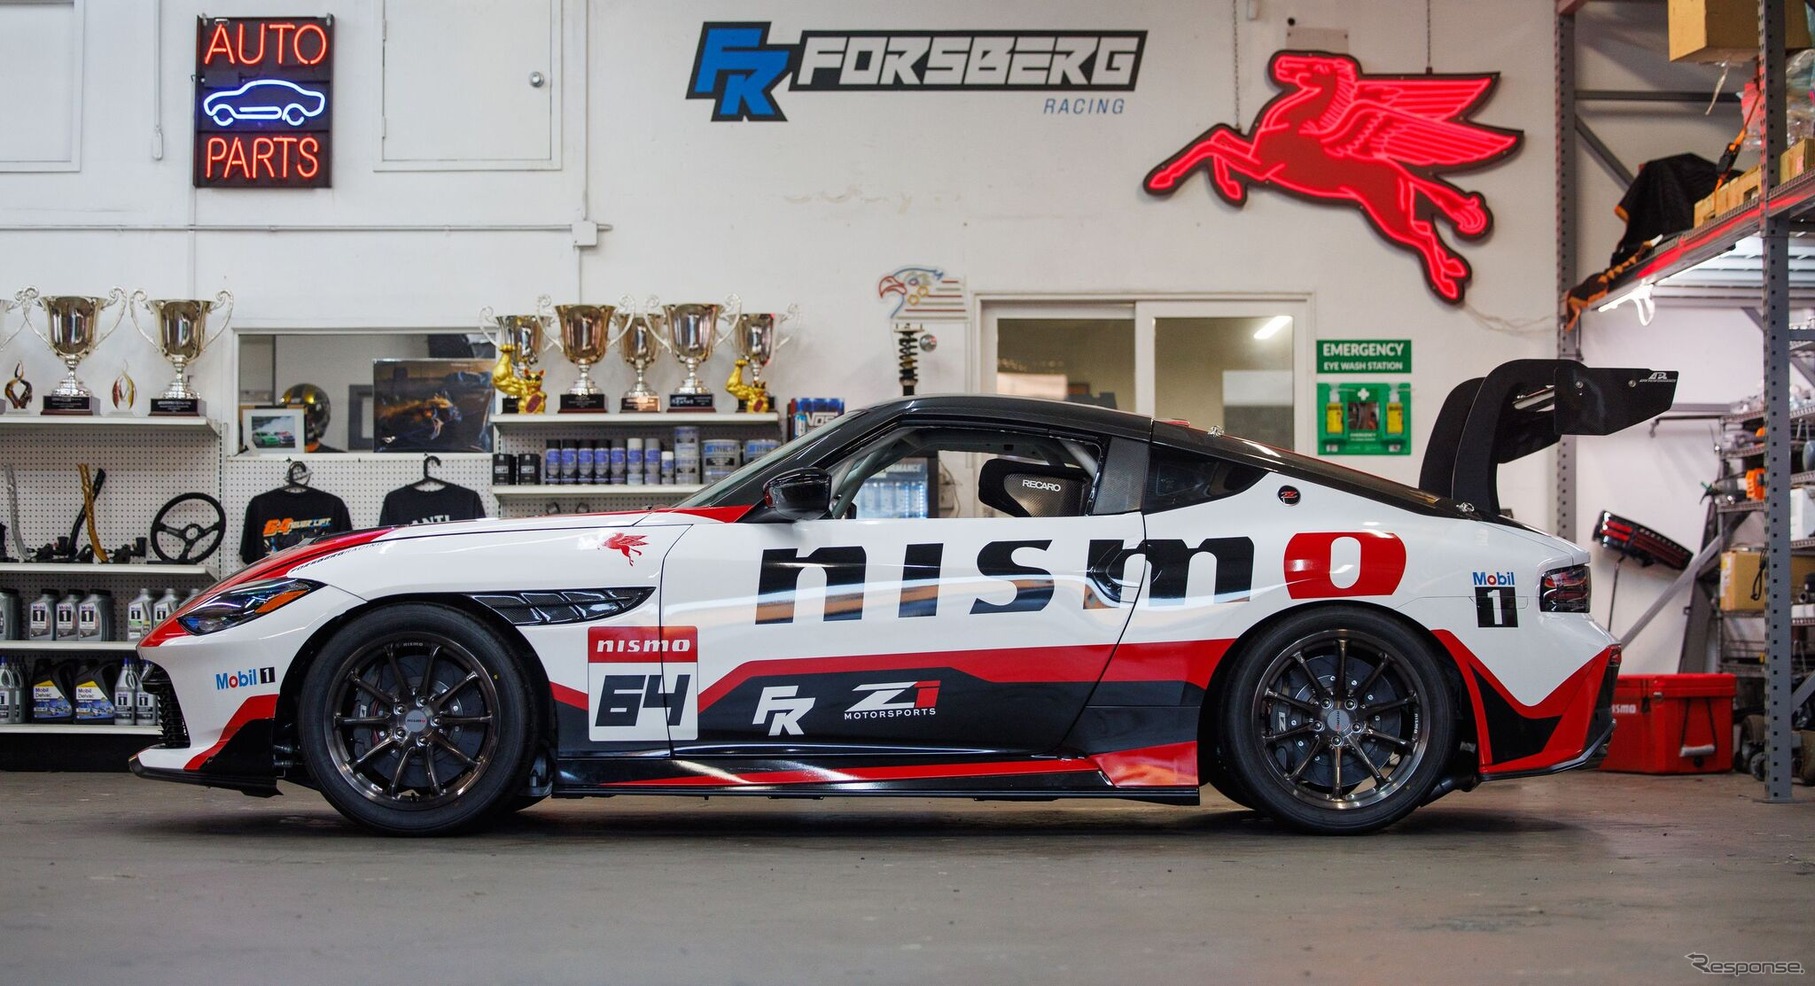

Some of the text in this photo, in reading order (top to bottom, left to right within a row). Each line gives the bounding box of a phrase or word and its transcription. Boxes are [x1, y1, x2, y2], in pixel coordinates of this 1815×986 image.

[204, 22, 327, 65] AUTO
[797, 36, 1140, 86] FORSBERG
[1043, 97, 1126, 115] RACING
[206, 136, 319, 179] PARTS
[1322, 343, 1405, 356] EMERGENCY
[1323, 361, 1403, 371] EYE WASH STATION
[1022, 479, 1061, 493] RECARO
[263, 517, 294, 537] 64
[755, 531, 1407, 625] nismo
[1472, 571, 1515, 586] Mobil
[1487, 589, 1503, 625] 1
[596, 638, 691, 653] nismo
[215, 668, 257, 690] Mobil
[594, 674, 691, 727] 64
[845, 680, 941, 713] Z1
[752, 685, 816, 736] FR
[844, 707, 936, 720] MOTORSPORTS
[1611, 703, 1637, 714] ismo
